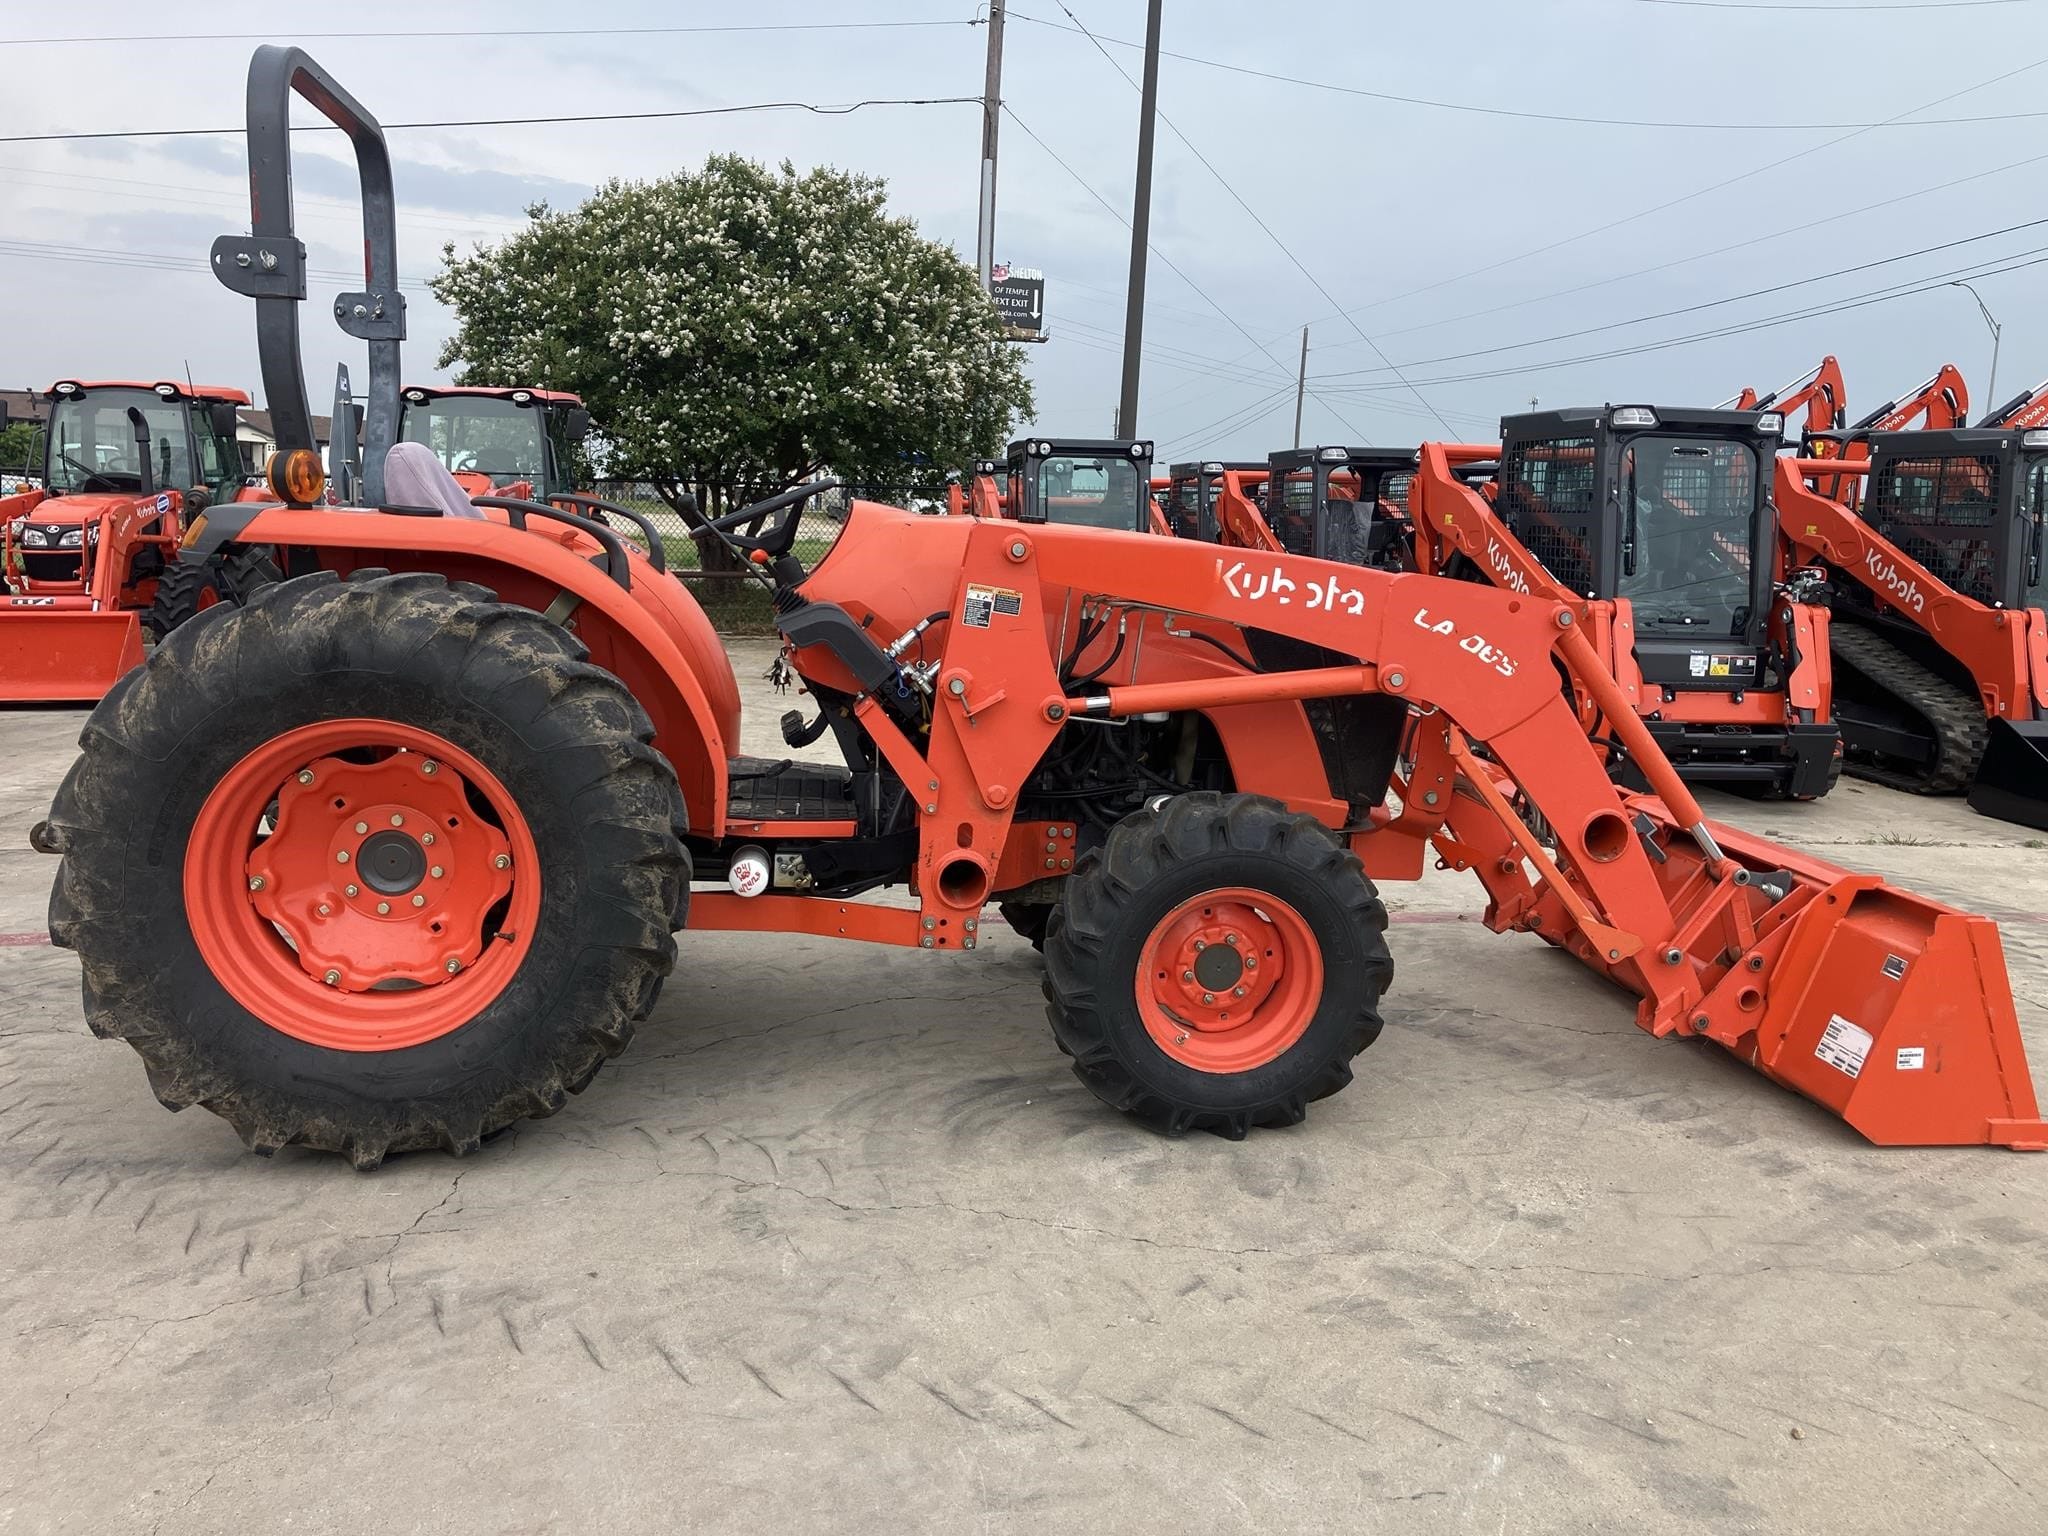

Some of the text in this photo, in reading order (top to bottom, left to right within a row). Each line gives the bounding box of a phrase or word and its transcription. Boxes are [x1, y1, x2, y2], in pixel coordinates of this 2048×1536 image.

[1009, 266, 1042, 280] SHELTON
[1005, 287, 1029, 296] TEMPLE
[1011, 298, 1028, 308] EXIT
[1878, 414, 1905, 431] ubota
[1216, 558, 1365, 616] Kubota
[1865, 547, 1924, 613] Kubota
